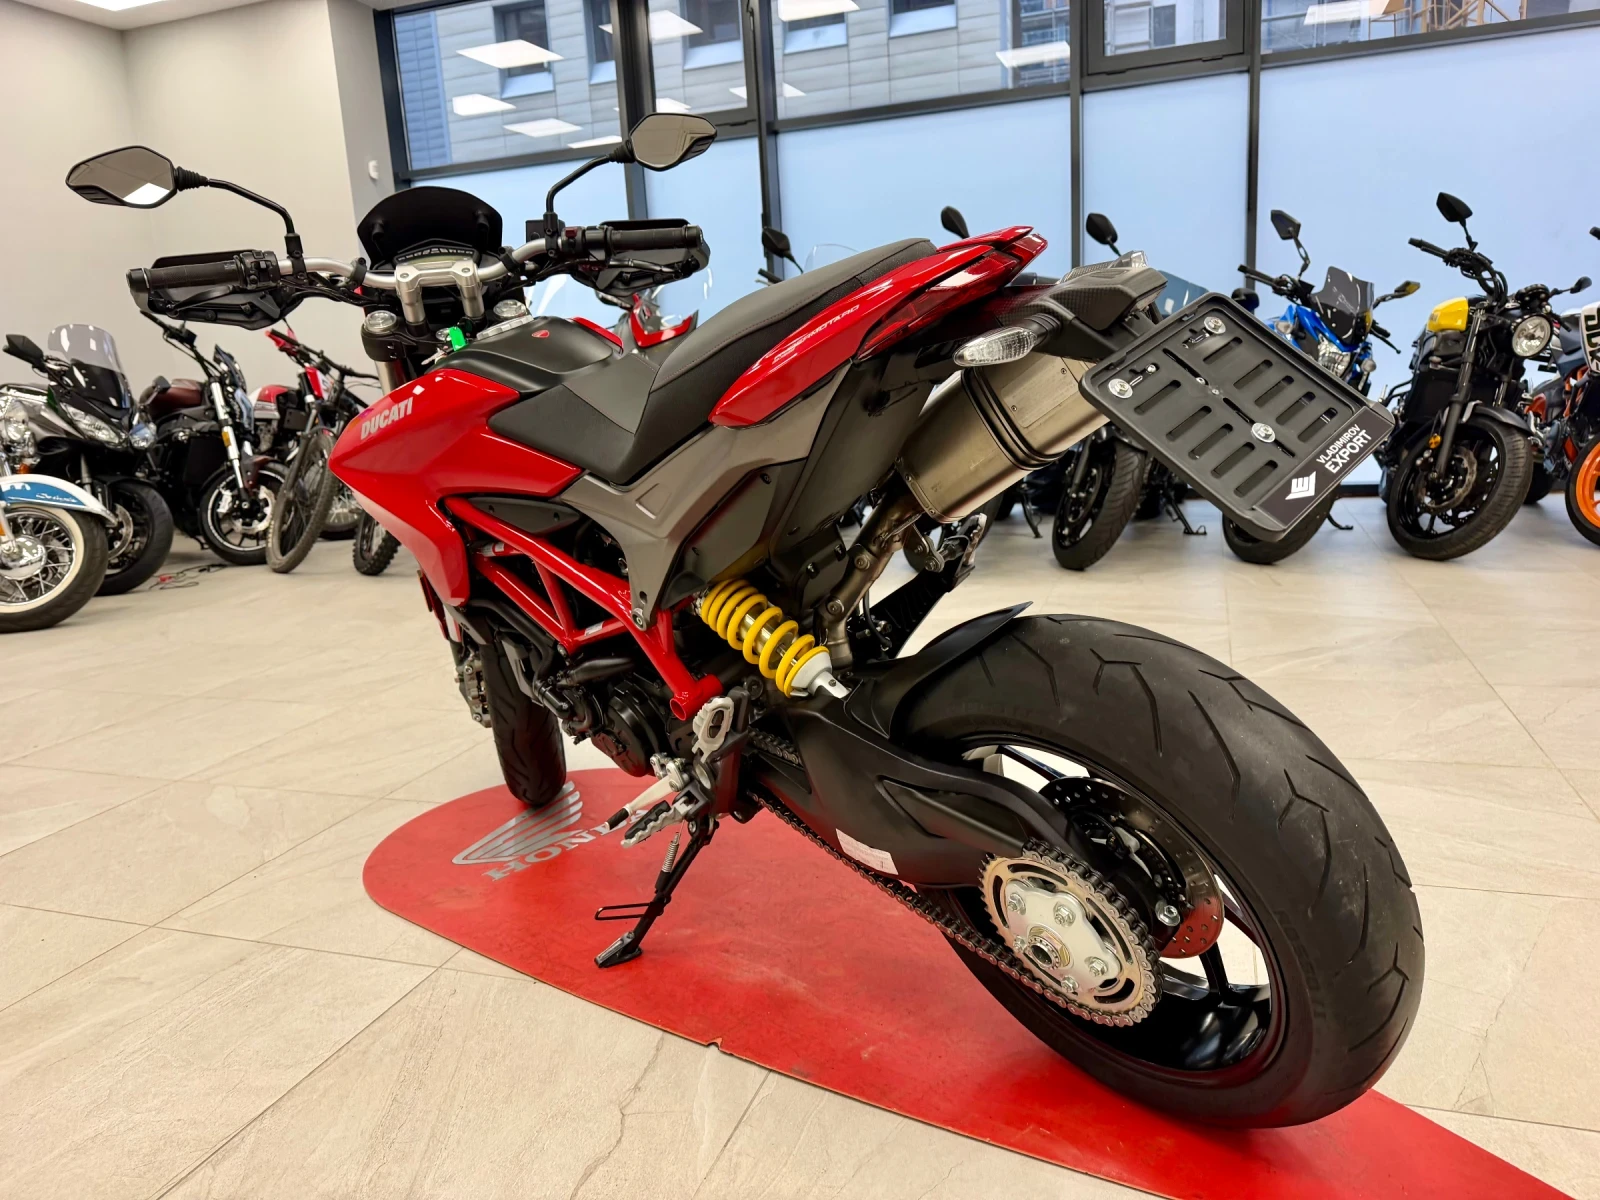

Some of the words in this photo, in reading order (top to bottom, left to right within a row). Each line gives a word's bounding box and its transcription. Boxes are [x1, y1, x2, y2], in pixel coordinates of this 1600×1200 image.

[773, 304, 860, 364] ERMOTARD
[361, 397, 413, 440] DUCATI
[1316, 423, 1361, 464] VLADIMIROV
[1324, 429, 1372, 474] EXPORT
